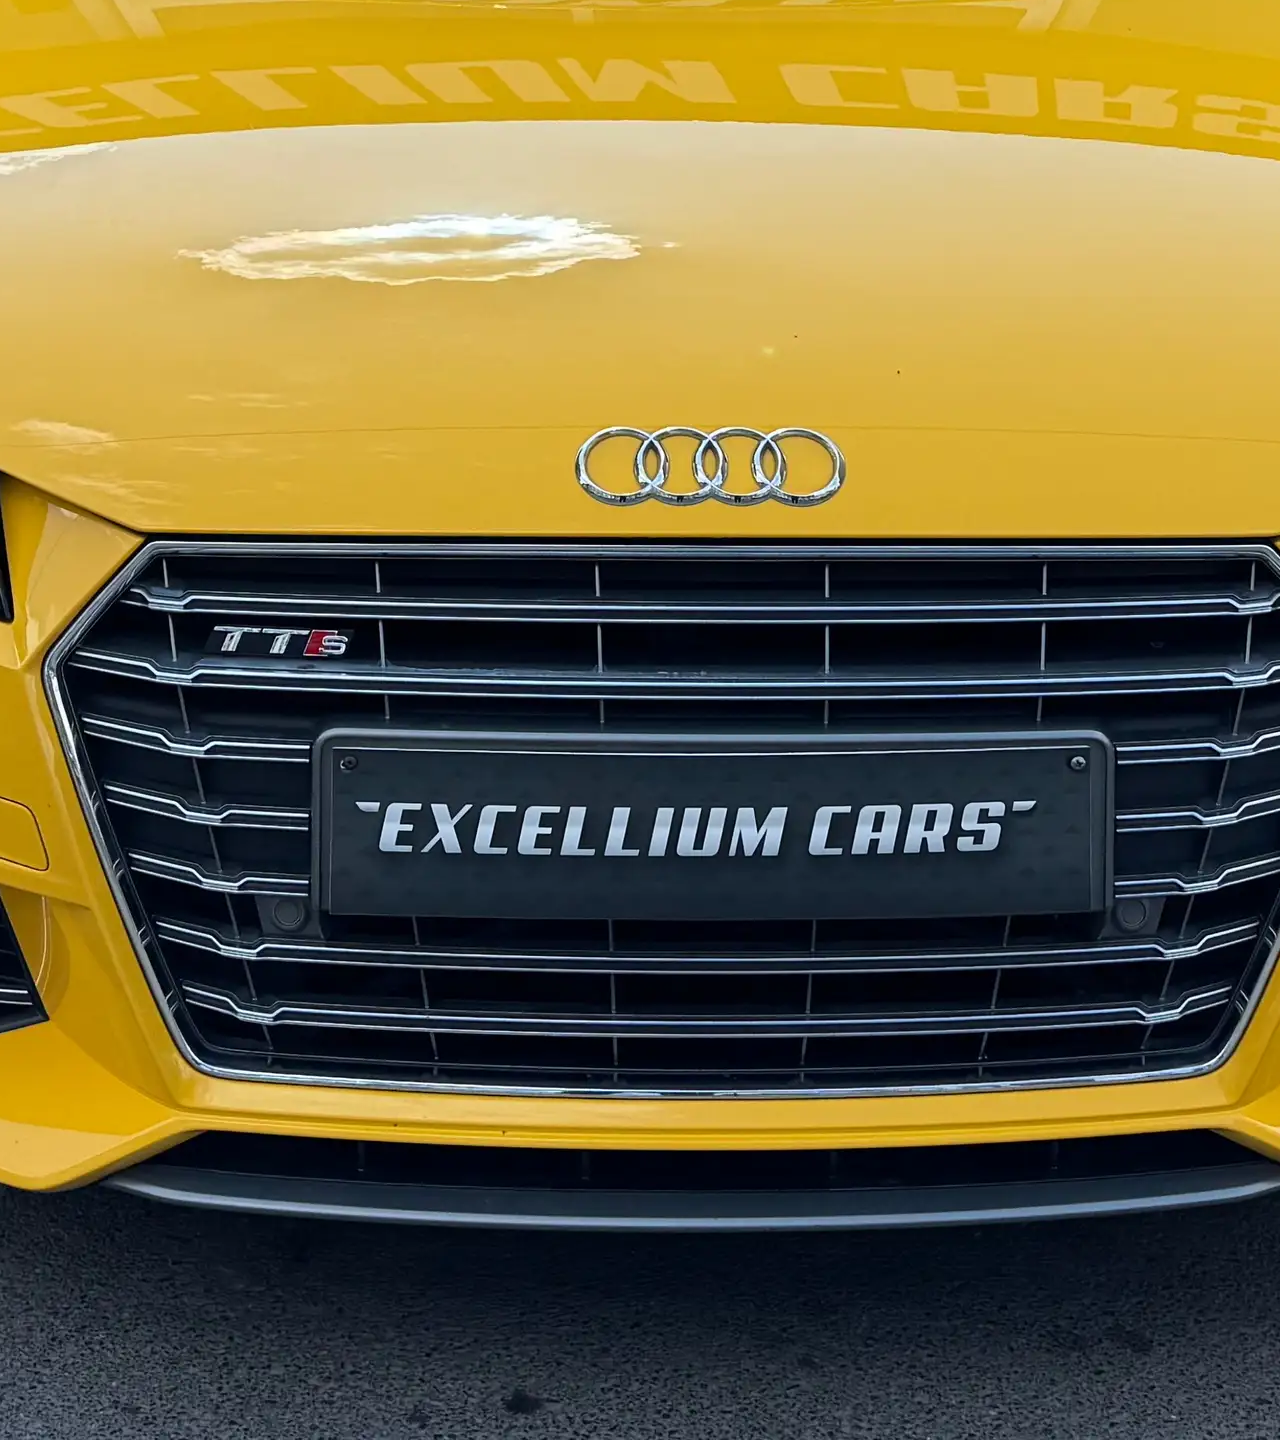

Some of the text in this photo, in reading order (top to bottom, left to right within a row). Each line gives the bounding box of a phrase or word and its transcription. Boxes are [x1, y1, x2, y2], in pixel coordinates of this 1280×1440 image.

[213, 625, 348, 656] TTS
[377, 801, 1006, 857] EXCELLIUM CARS
